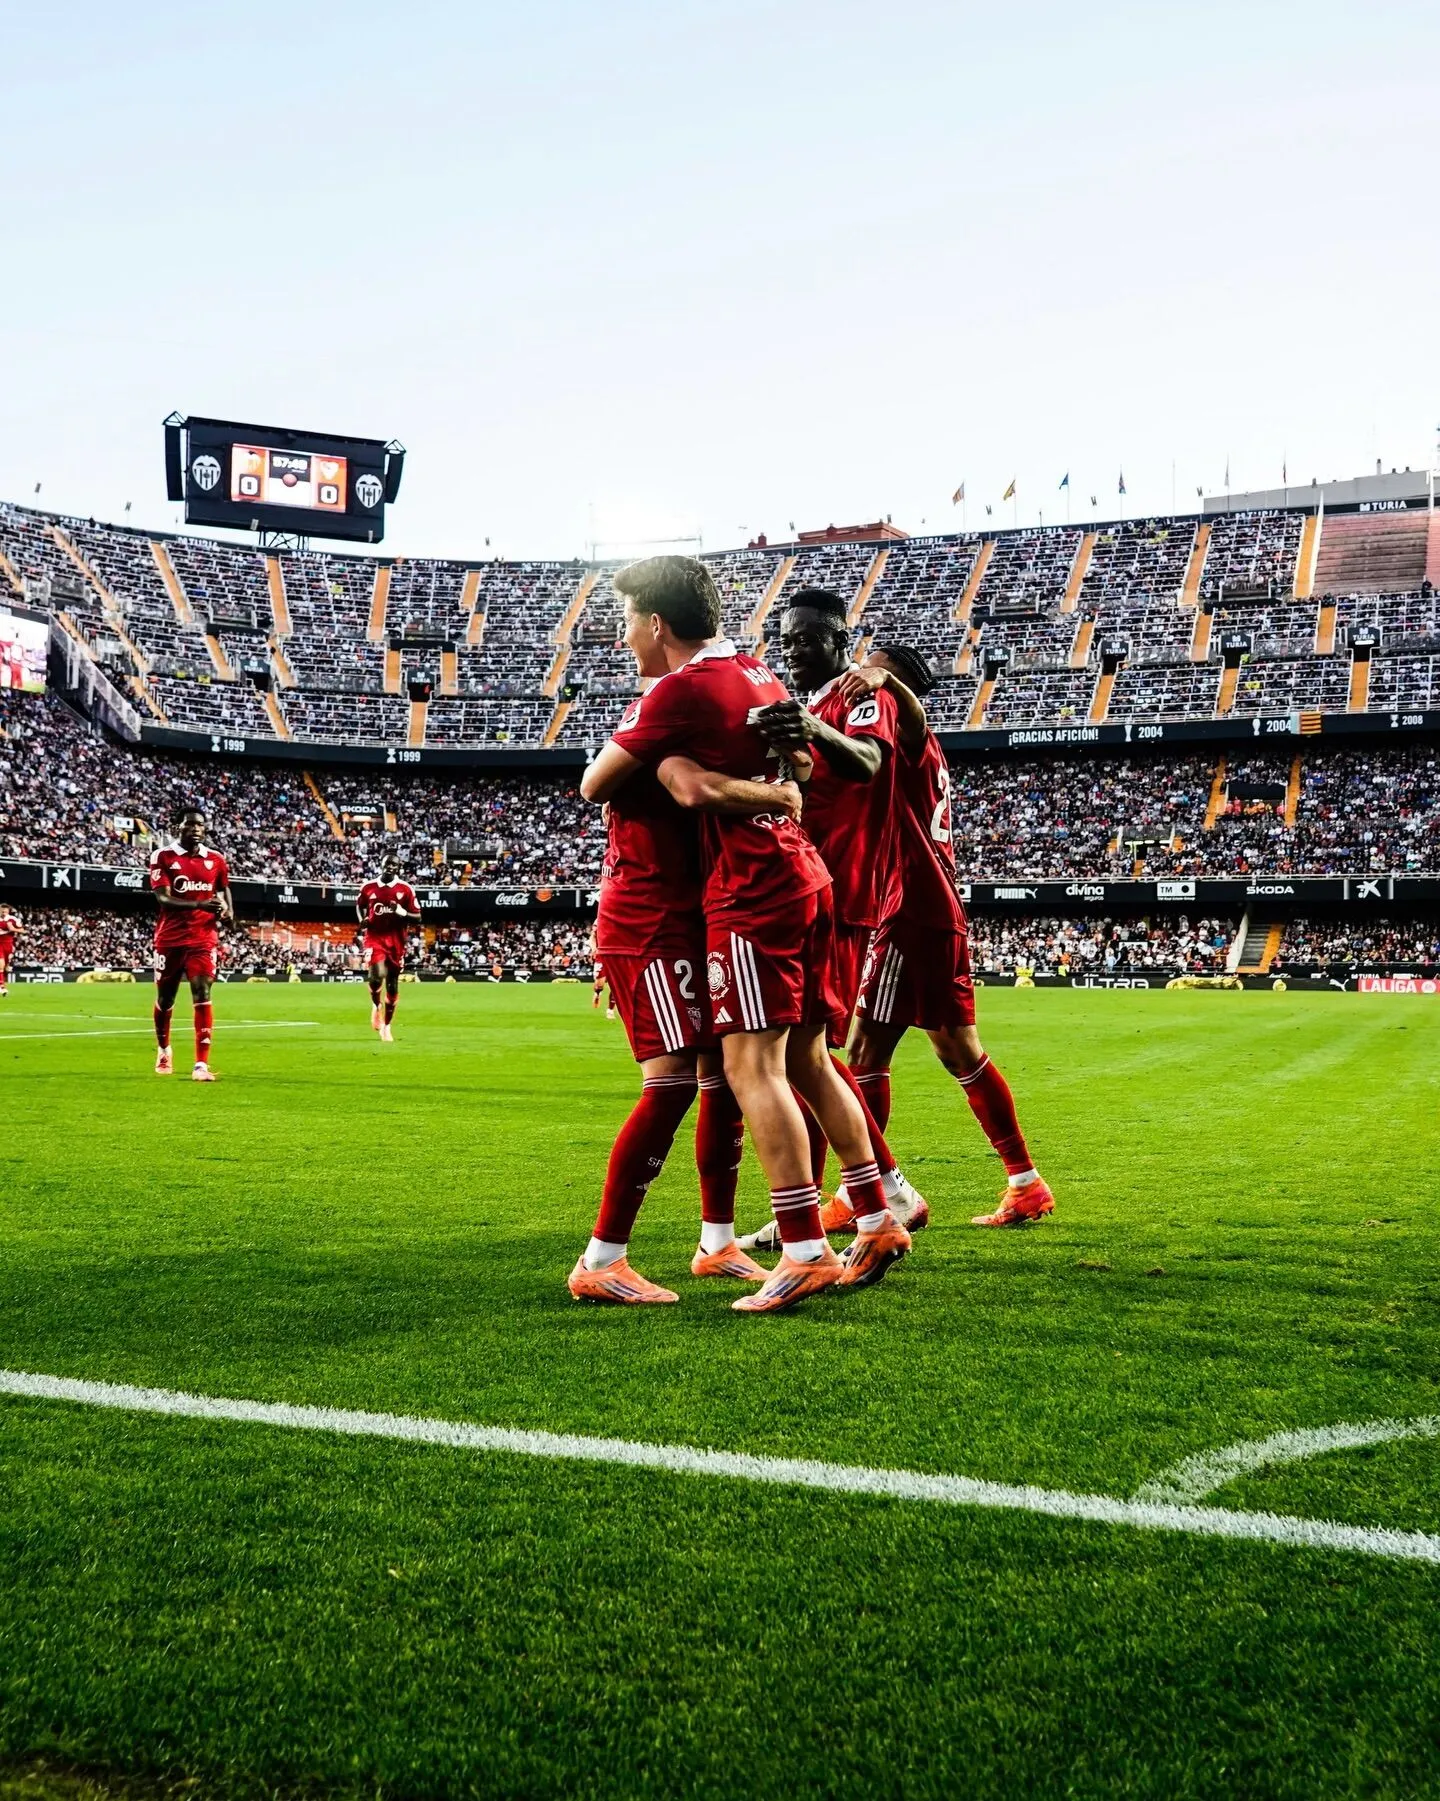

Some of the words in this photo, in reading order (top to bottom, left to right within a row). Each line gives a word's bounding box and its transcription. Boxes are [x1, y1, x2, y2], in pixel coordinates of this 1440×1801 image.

[240, 476, 258, 495] 0
[320, 485, 338, 504] 0
[1371, 500, 1407, 511] TURIA
[1353, 633, 1376, 641] TURIA
[988, 654, 1009, 662] TURIA
[852, 705, 875, 722] JD
[1266, 719, 1291, 732] 2004
[1402, 715, 1423, 725] 2008
[1008, 730, 1053, 746] ¡GRACIAS
[1055, 727, 1099, 742] AFICIÓN!
[1138, 726, 1163, 738] 2004
[223, 739, 245, 752] 1999
[398, 751, 421, 762] 1999
[340, 806, 378, 814] SKODA
[180, 880, 213, 892] Midea
[1066, 884, 1104, 896] divina
[1246, 886, 1295, 894] SKODA
[278, 895, 299, 903] TURIA
[994, 888, 1026, 899] PUMA
[420, 900, 449, 908] TURIA
[674, 959, 695, 999] 2
[1071, 978, 1149, 989] ULTRA
[1360, 979, 1418, 993] LALIGA
